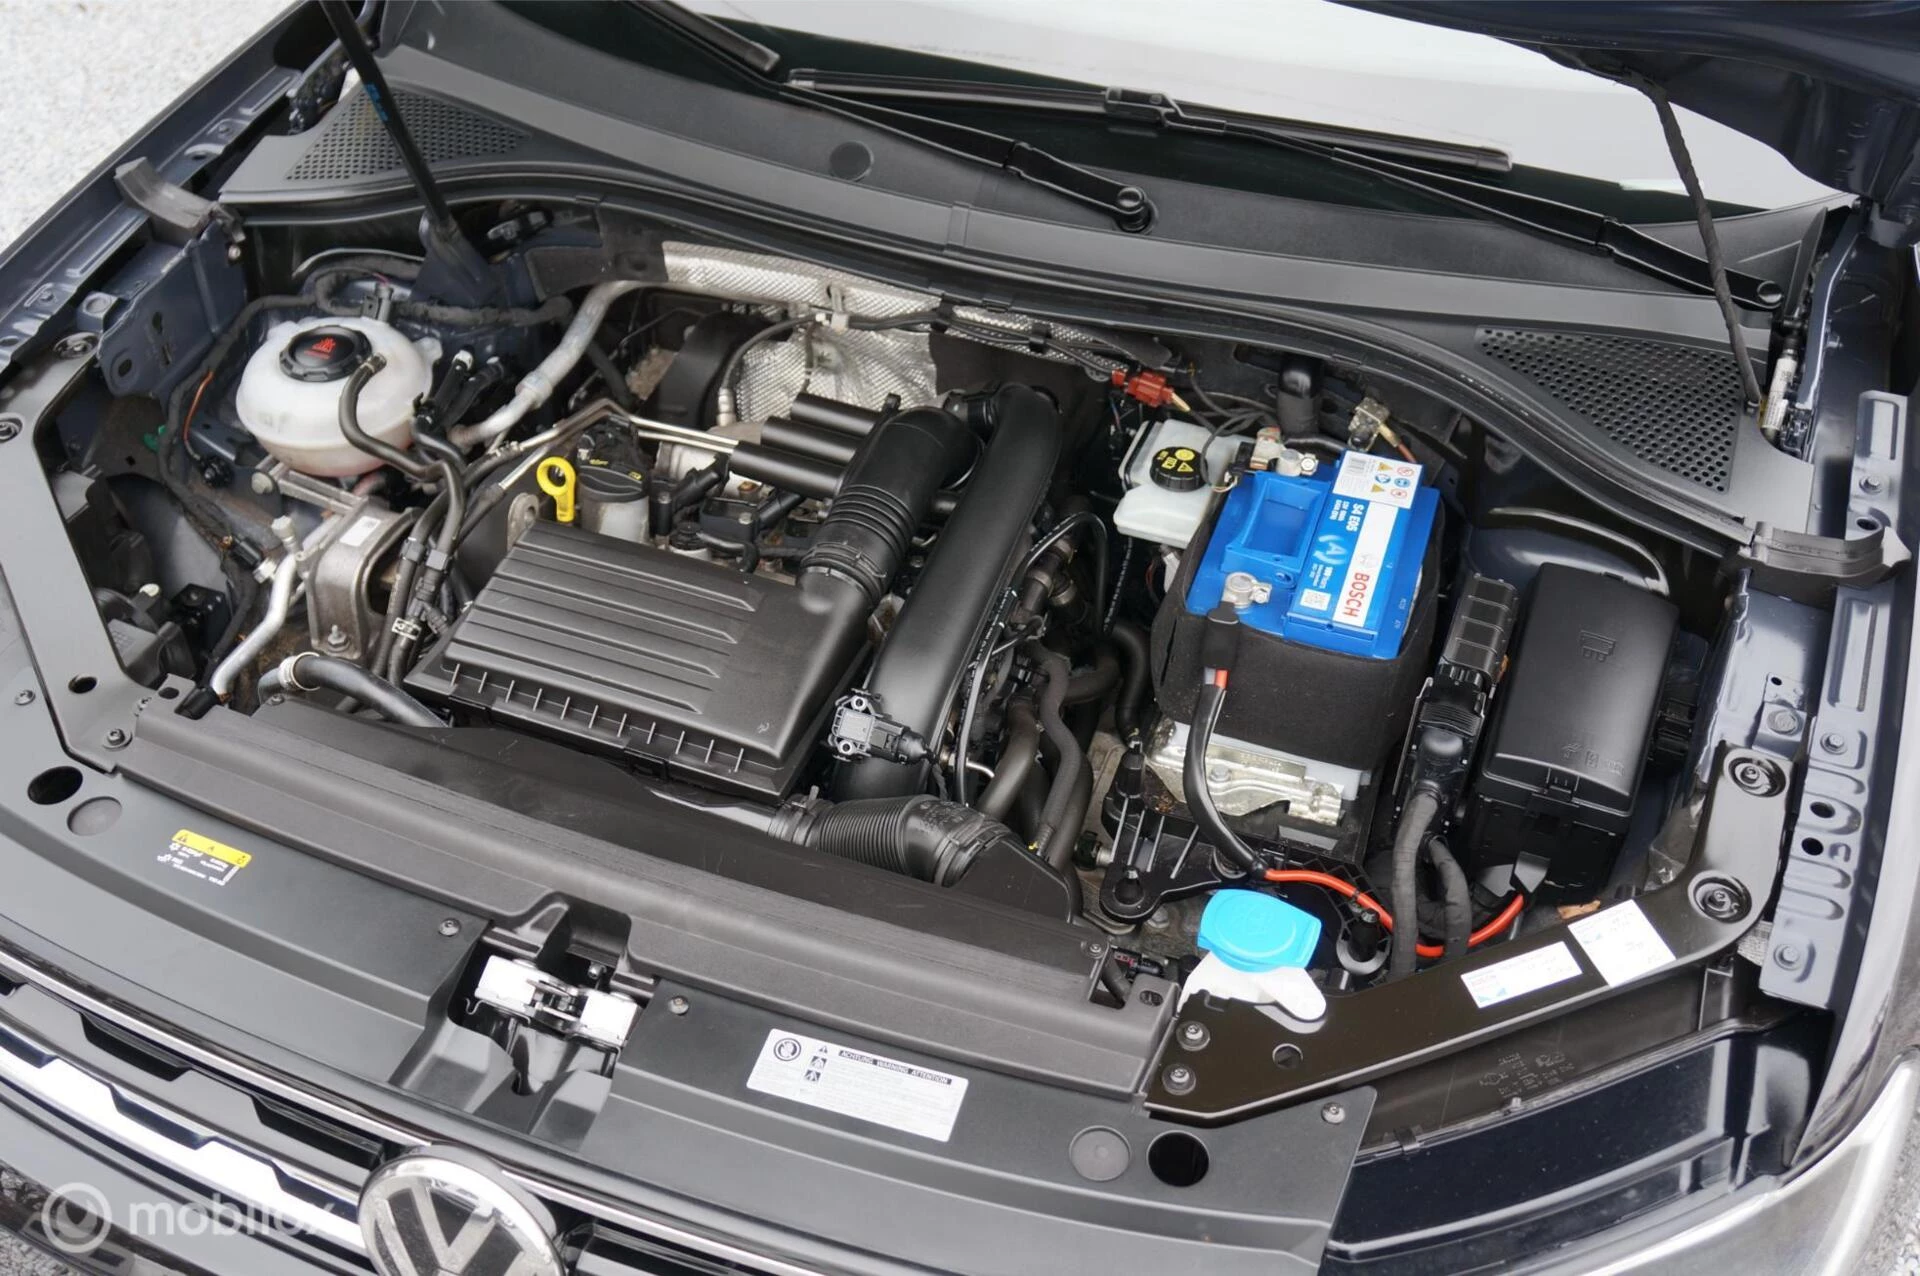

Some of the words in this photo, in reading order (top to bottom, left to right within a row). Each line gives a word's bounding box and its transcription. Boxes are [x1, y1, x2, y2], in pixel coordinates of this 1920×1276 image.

[1352, 503, 1365, 515] S4
[1343, 572, 1370, 617] BOSCH
[841, 1051, 873, 1064] ACHTUNG
[877, 1060, 909, 1074] WARNING
[911, 1069, 948, 1084] ATTENTION
